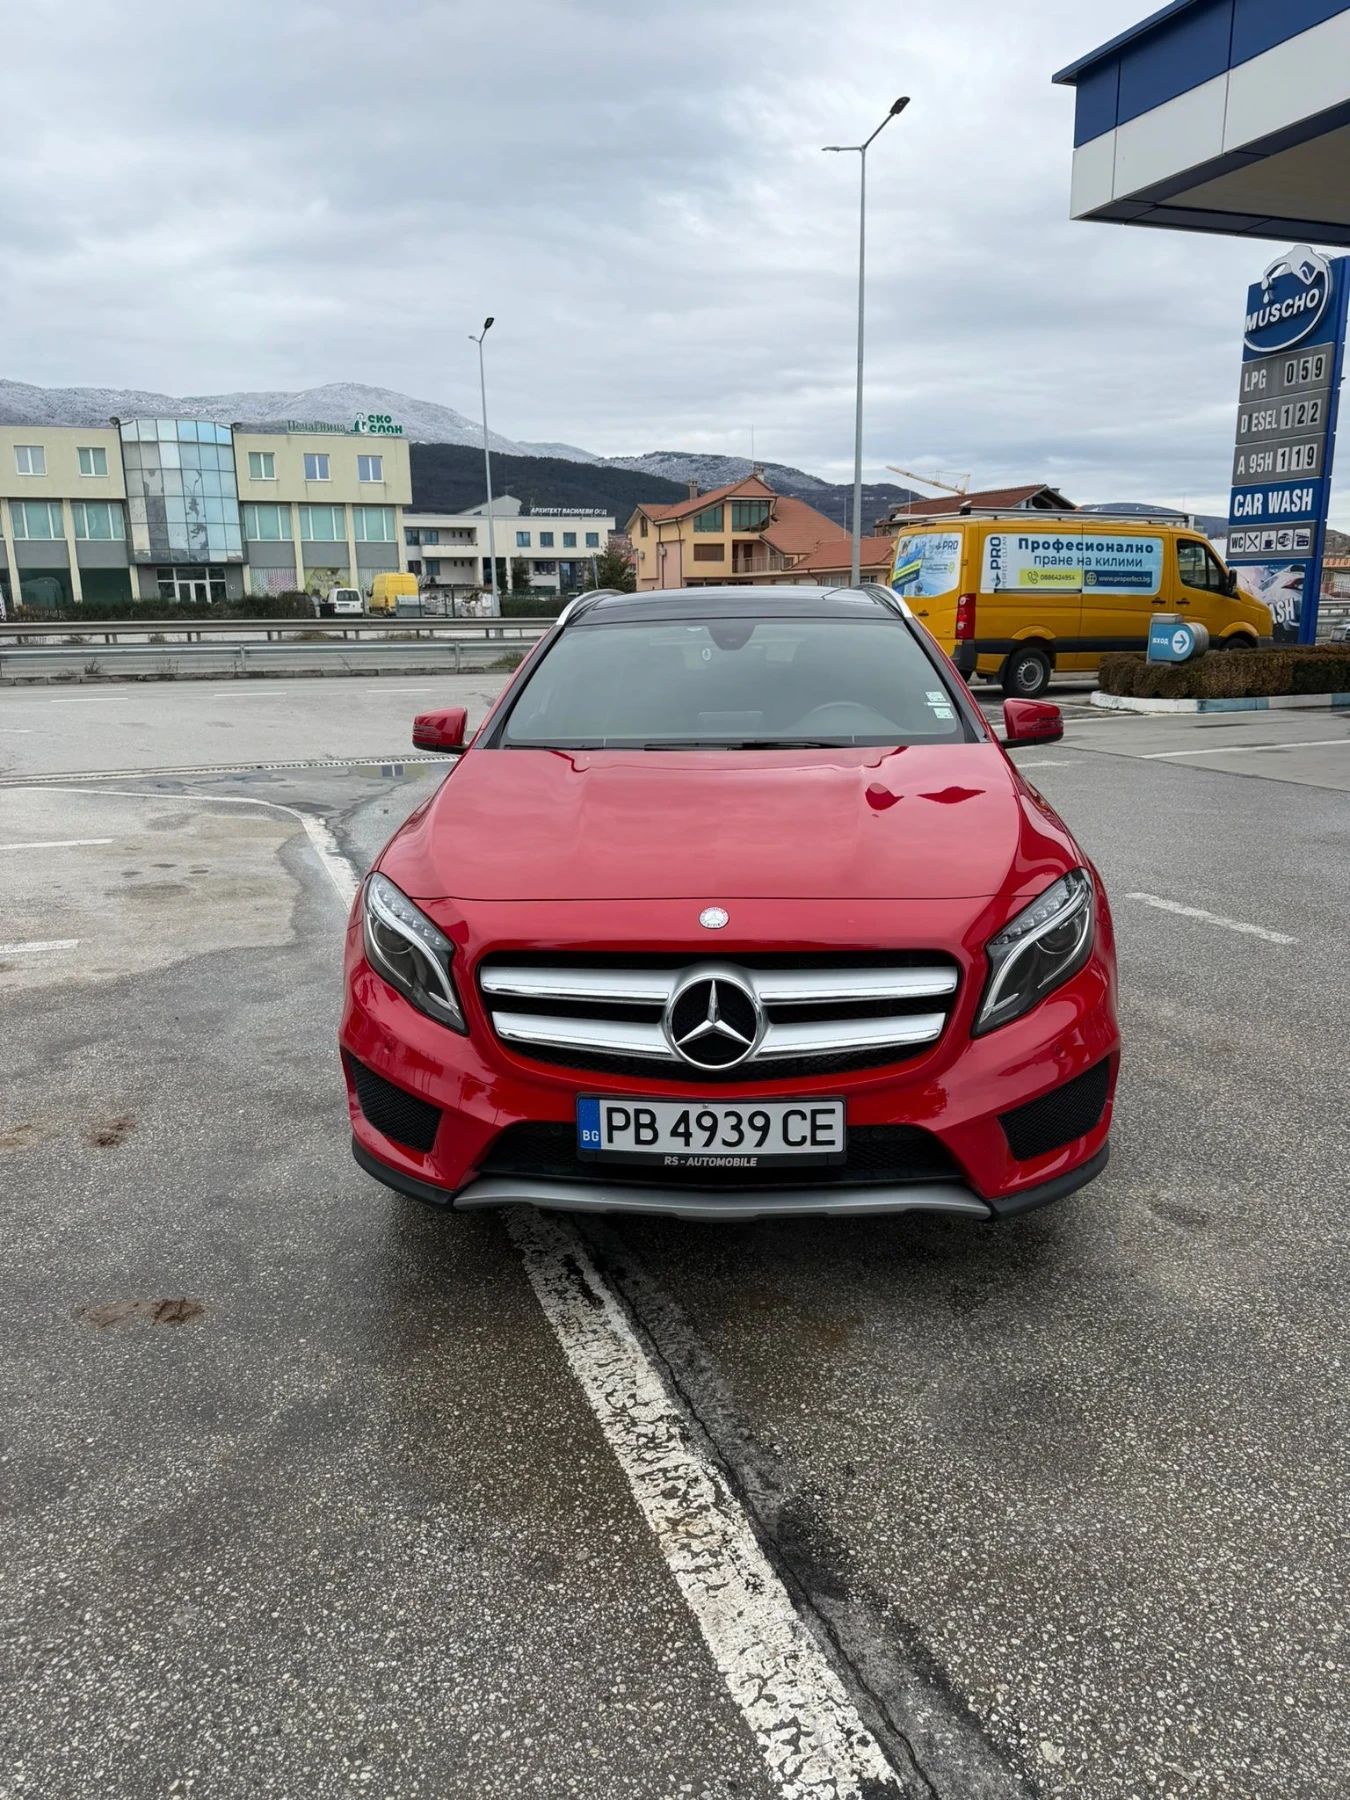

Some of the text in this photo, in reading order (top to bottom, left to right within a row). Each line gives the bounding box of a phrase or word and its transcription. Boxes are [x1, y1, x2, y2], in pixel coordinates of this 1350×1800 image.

[1245, 288, 1319, 333] MUSCHO
[1244, 369, 1267, 392] LPG
[1237, 455, 1245, 475] A
[1249, 451, 1273, 473] 95H
[1233, 488, 1313, 517] CAR WASH
[942, 540, 958, 550] PRO
[1018, 538, 1154, 553] Професионално
[1231, 536, 1244, 549] WC
[990, 536, 1001, 570] PRO
[1034, 555, 1143, 567] пране на килими
[1269, 598, 1295, 624] ASH
[1152, 637, 1169, 645] ВХОД
[582, 1130, 599, 1142] BG
[606, 1107, 836, 1148] PB 4939 CE
[664, 1156, 679, 1165] RS
[687, 1156, 757, 1167] AUTOMOBILE
